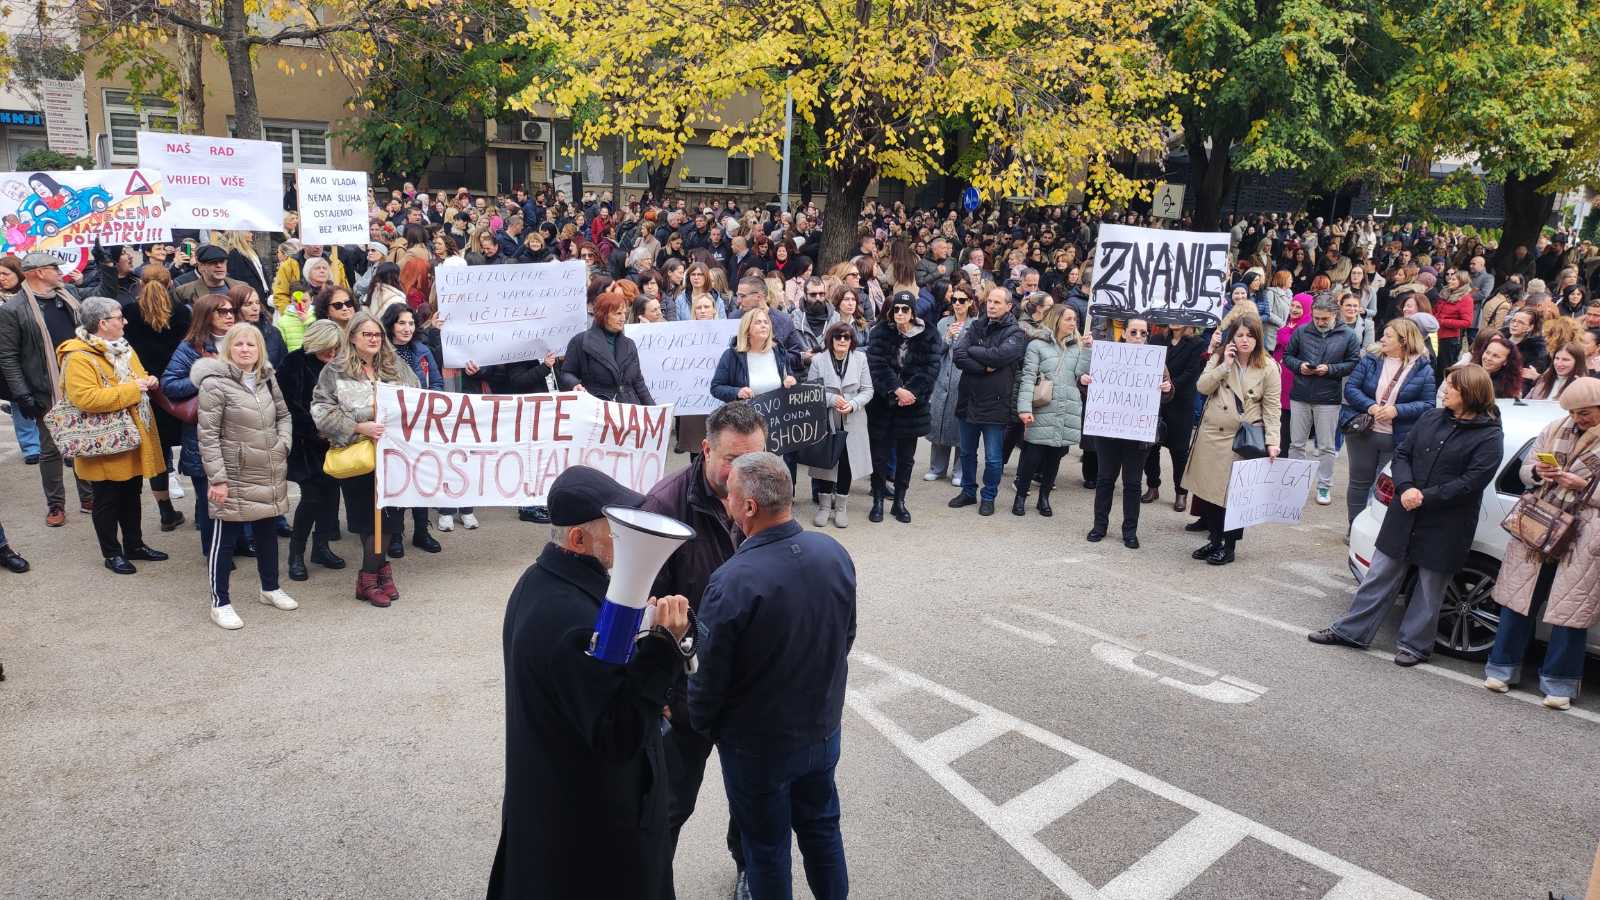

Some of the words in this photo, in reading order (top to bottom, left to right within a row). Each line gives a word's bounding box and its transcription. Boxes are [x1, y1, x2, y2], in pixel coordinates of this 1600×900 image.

[166, 141, 192, 155] NAŠ
[209, 146, 235, 157] RAD
[167, 174, 211, 186] VRIJEDI
[220, 174, 246, 188] VIŠE
[309, 176, 328, 185] AKO
[332, 177, 357, 187] VLADA
[307, 193, 333, 203] NEMA
[337, 193, 362, 203] SLUHA
[192, 207, 210, 218] OD
[212, 207, 230, 218] 5%
[313, 208, 354, 219] OSTAJEMO
[319, 224, 333, 235] BEZ
[337, 223, 364, 234] KRUHA
[1092, 241, 1230, 308] ZNANJE
[788, 387, 825, 406] PRIHODI
[396, 388, 580, 444] VRATITE
[599, 400, 669, 452] NAM
[769, 415, 781, 428] PA
[783, 409, 812, 422] ONDA
